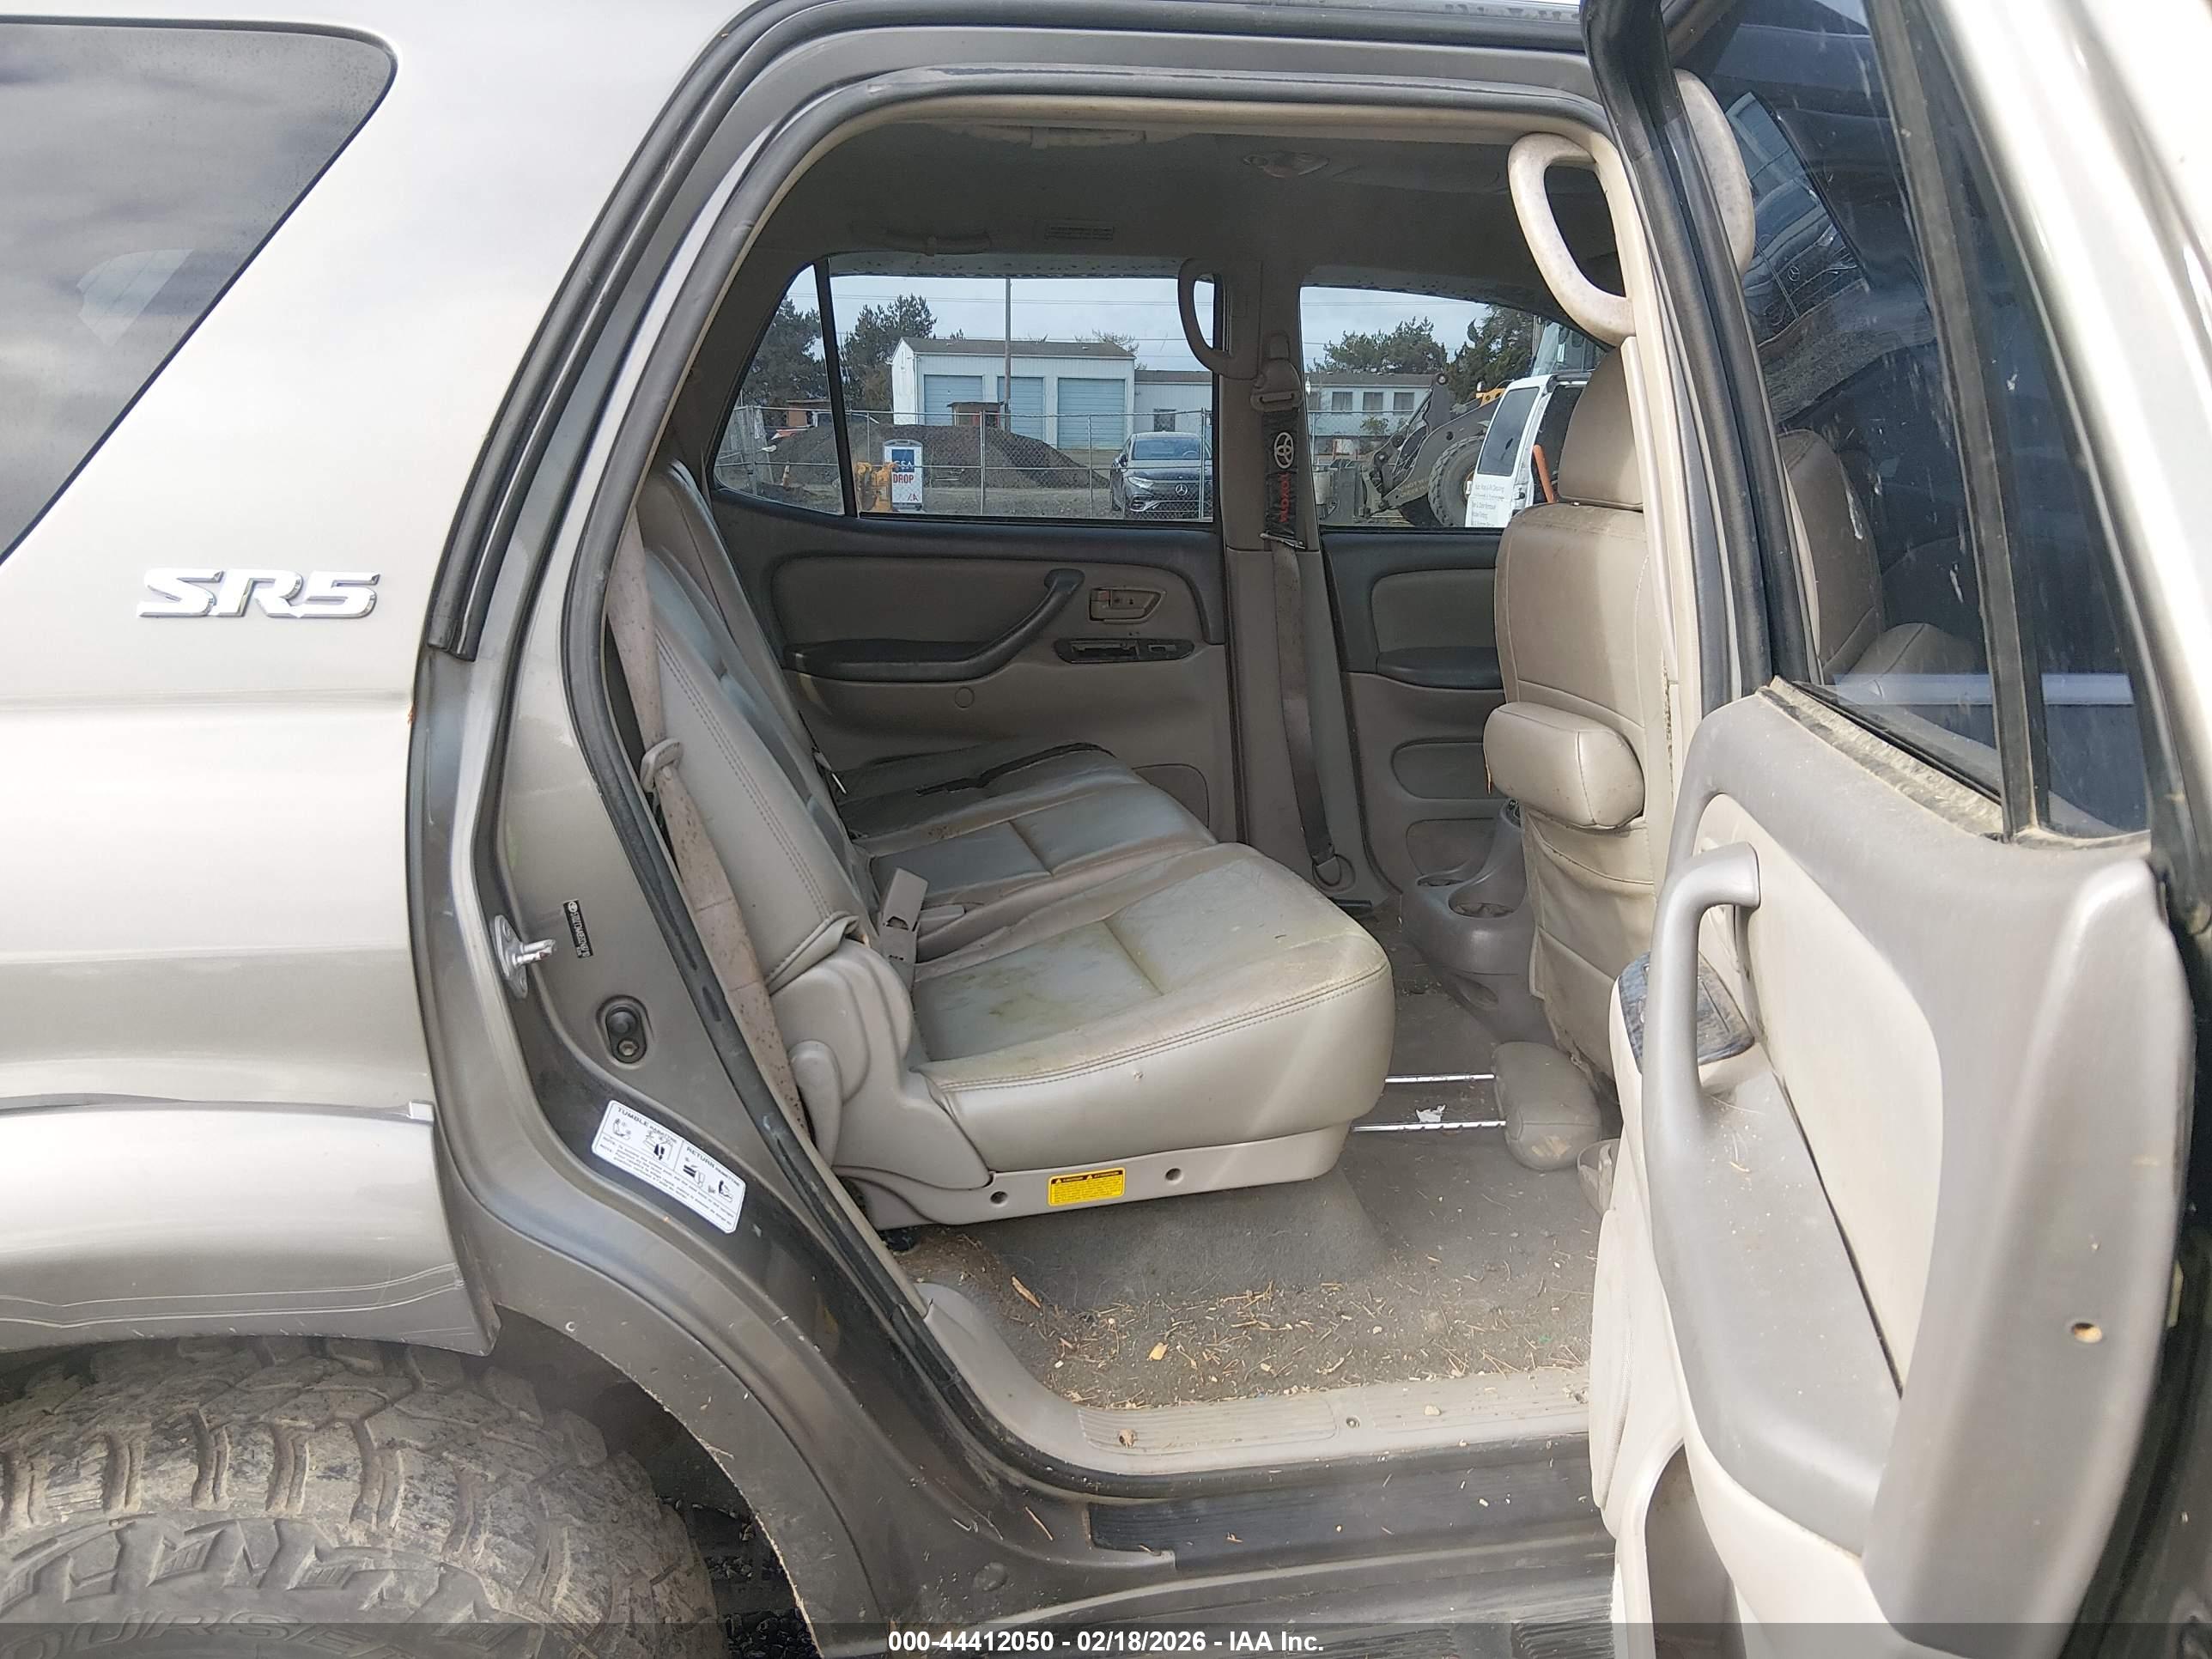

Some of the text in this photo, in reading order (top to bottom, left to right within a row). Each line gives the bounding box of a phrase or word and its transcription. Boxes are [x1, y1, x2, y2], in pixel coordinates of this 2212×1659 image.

[893, 473, 915, 484] DROP
[136, 567, 381, 619] SR5
[617, 1107, 650, 1128] TUMBLE
[686, 1146, 715, 1169] RETURN
